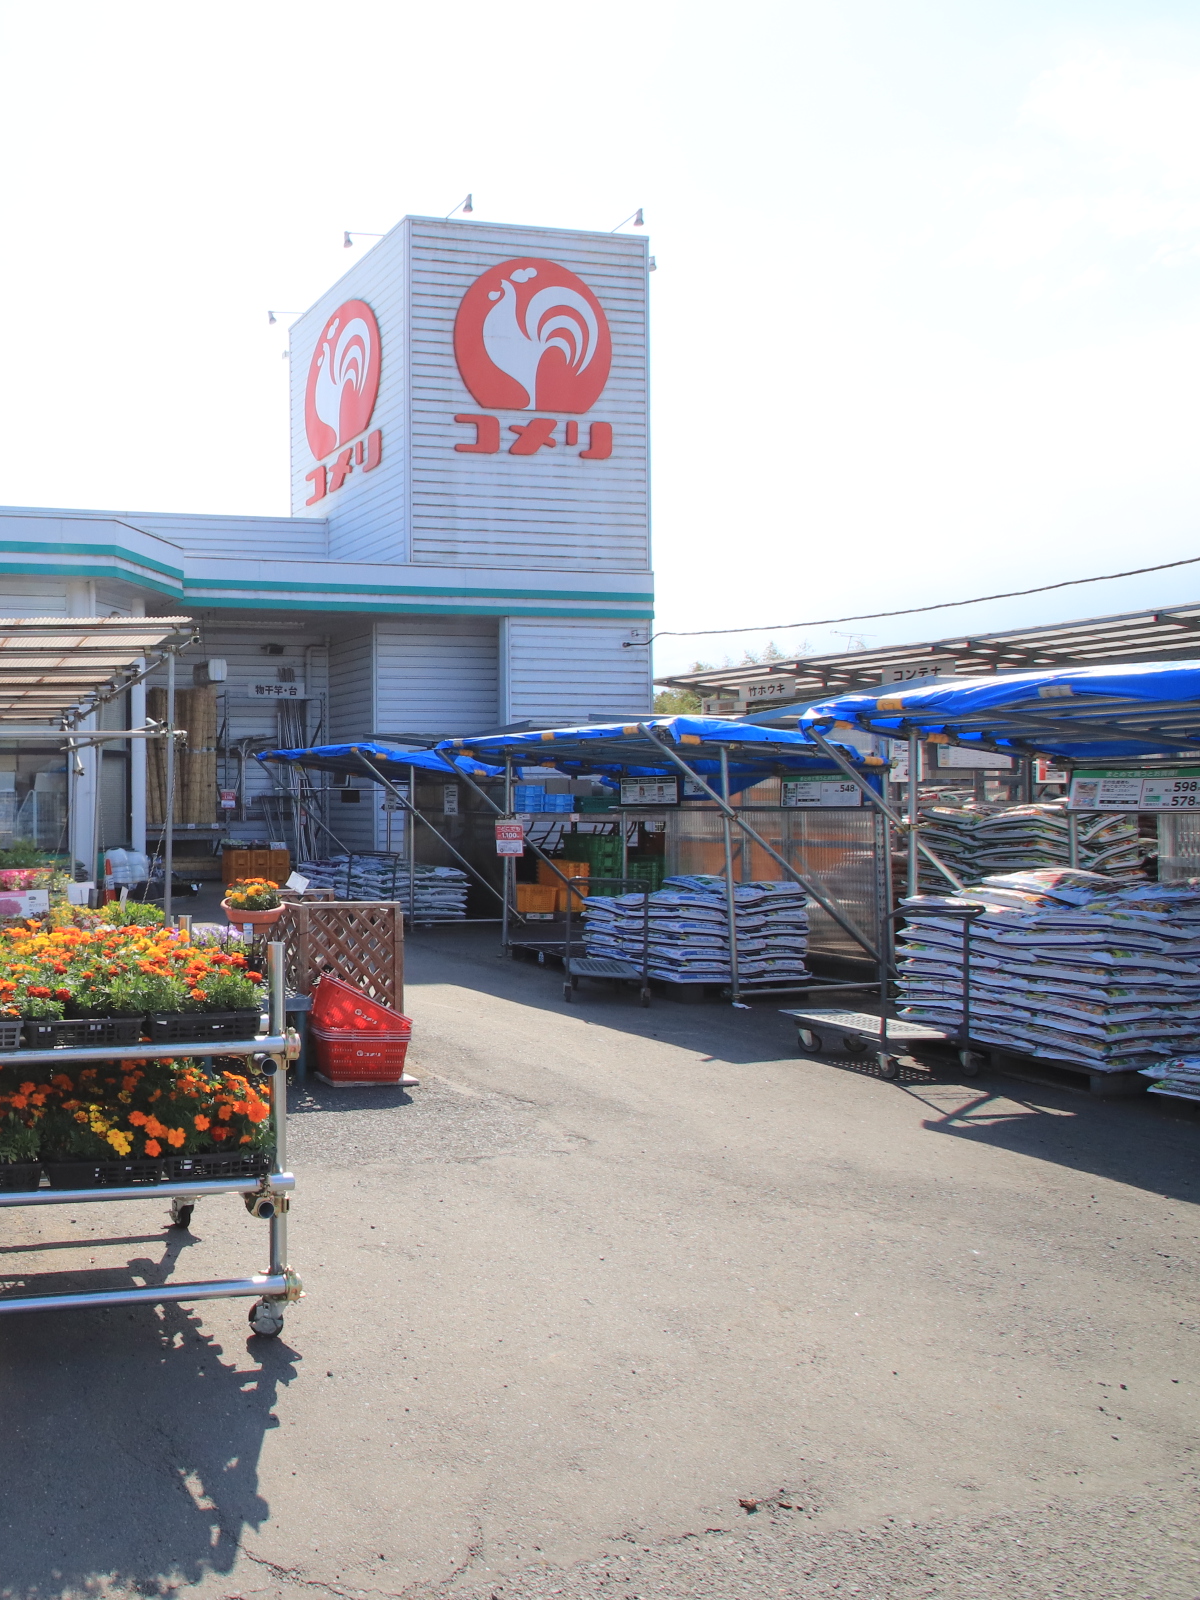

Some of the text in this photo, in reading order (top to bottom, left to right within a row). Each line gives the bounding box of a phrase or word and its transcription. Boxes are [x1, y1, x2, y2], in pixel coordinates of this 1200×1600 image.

[454, 413, 613, 460] コメリ
[305, 429, 382, 506] コメリ
[255, 685, 298, 696] 物干竿・台
[748, 683, 786, 697] 竹ホウキ
[840, 784, 855, 793] 548
[1173, 781, 1198, 792] 598
[1171, 795, 1196, 806] 578
